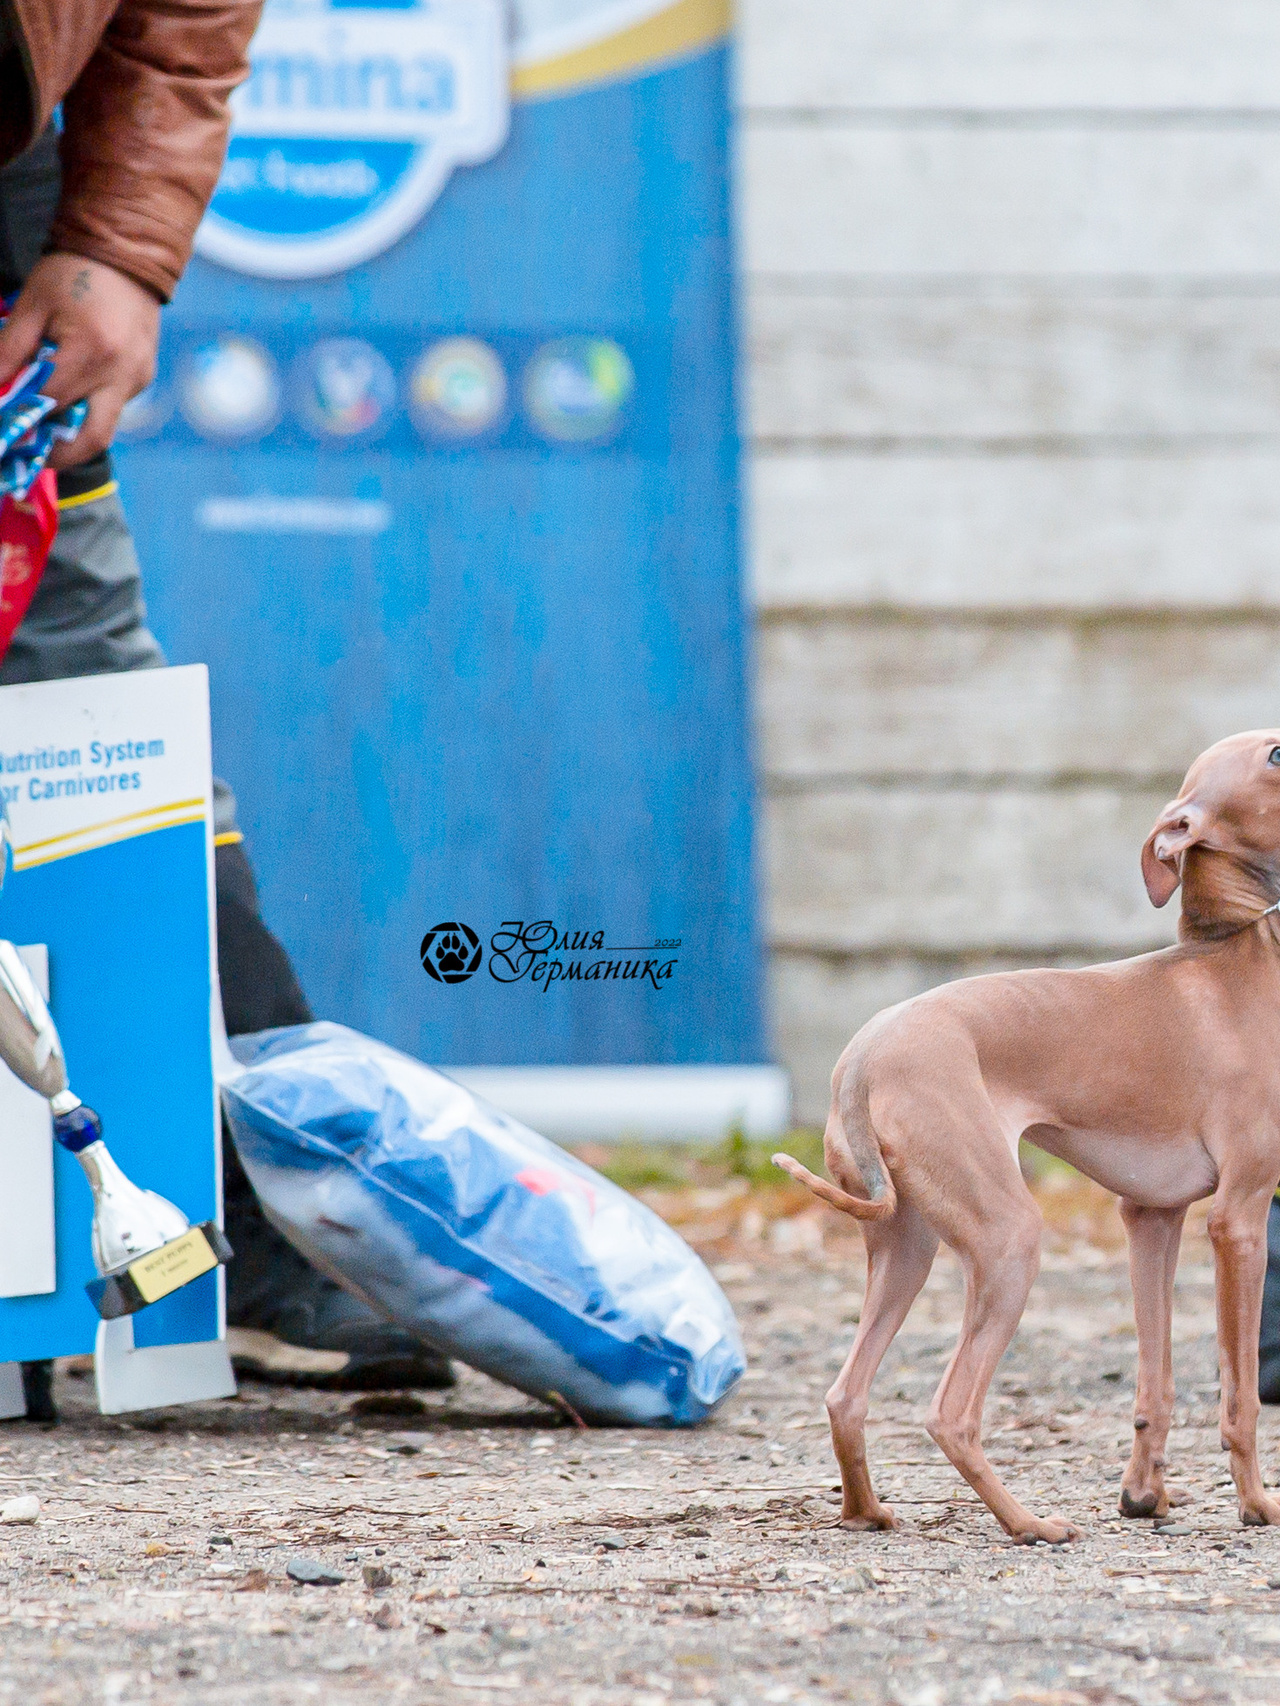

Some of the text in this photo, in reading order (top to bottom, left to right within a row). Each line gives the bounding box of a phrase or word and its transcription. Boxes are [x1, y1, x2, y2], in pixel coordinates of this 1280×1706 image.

[247, 30, 457, 112] mina
[0, 739, 165, 774] utrition System
[0, 771, 141, 803] or Carnivores
